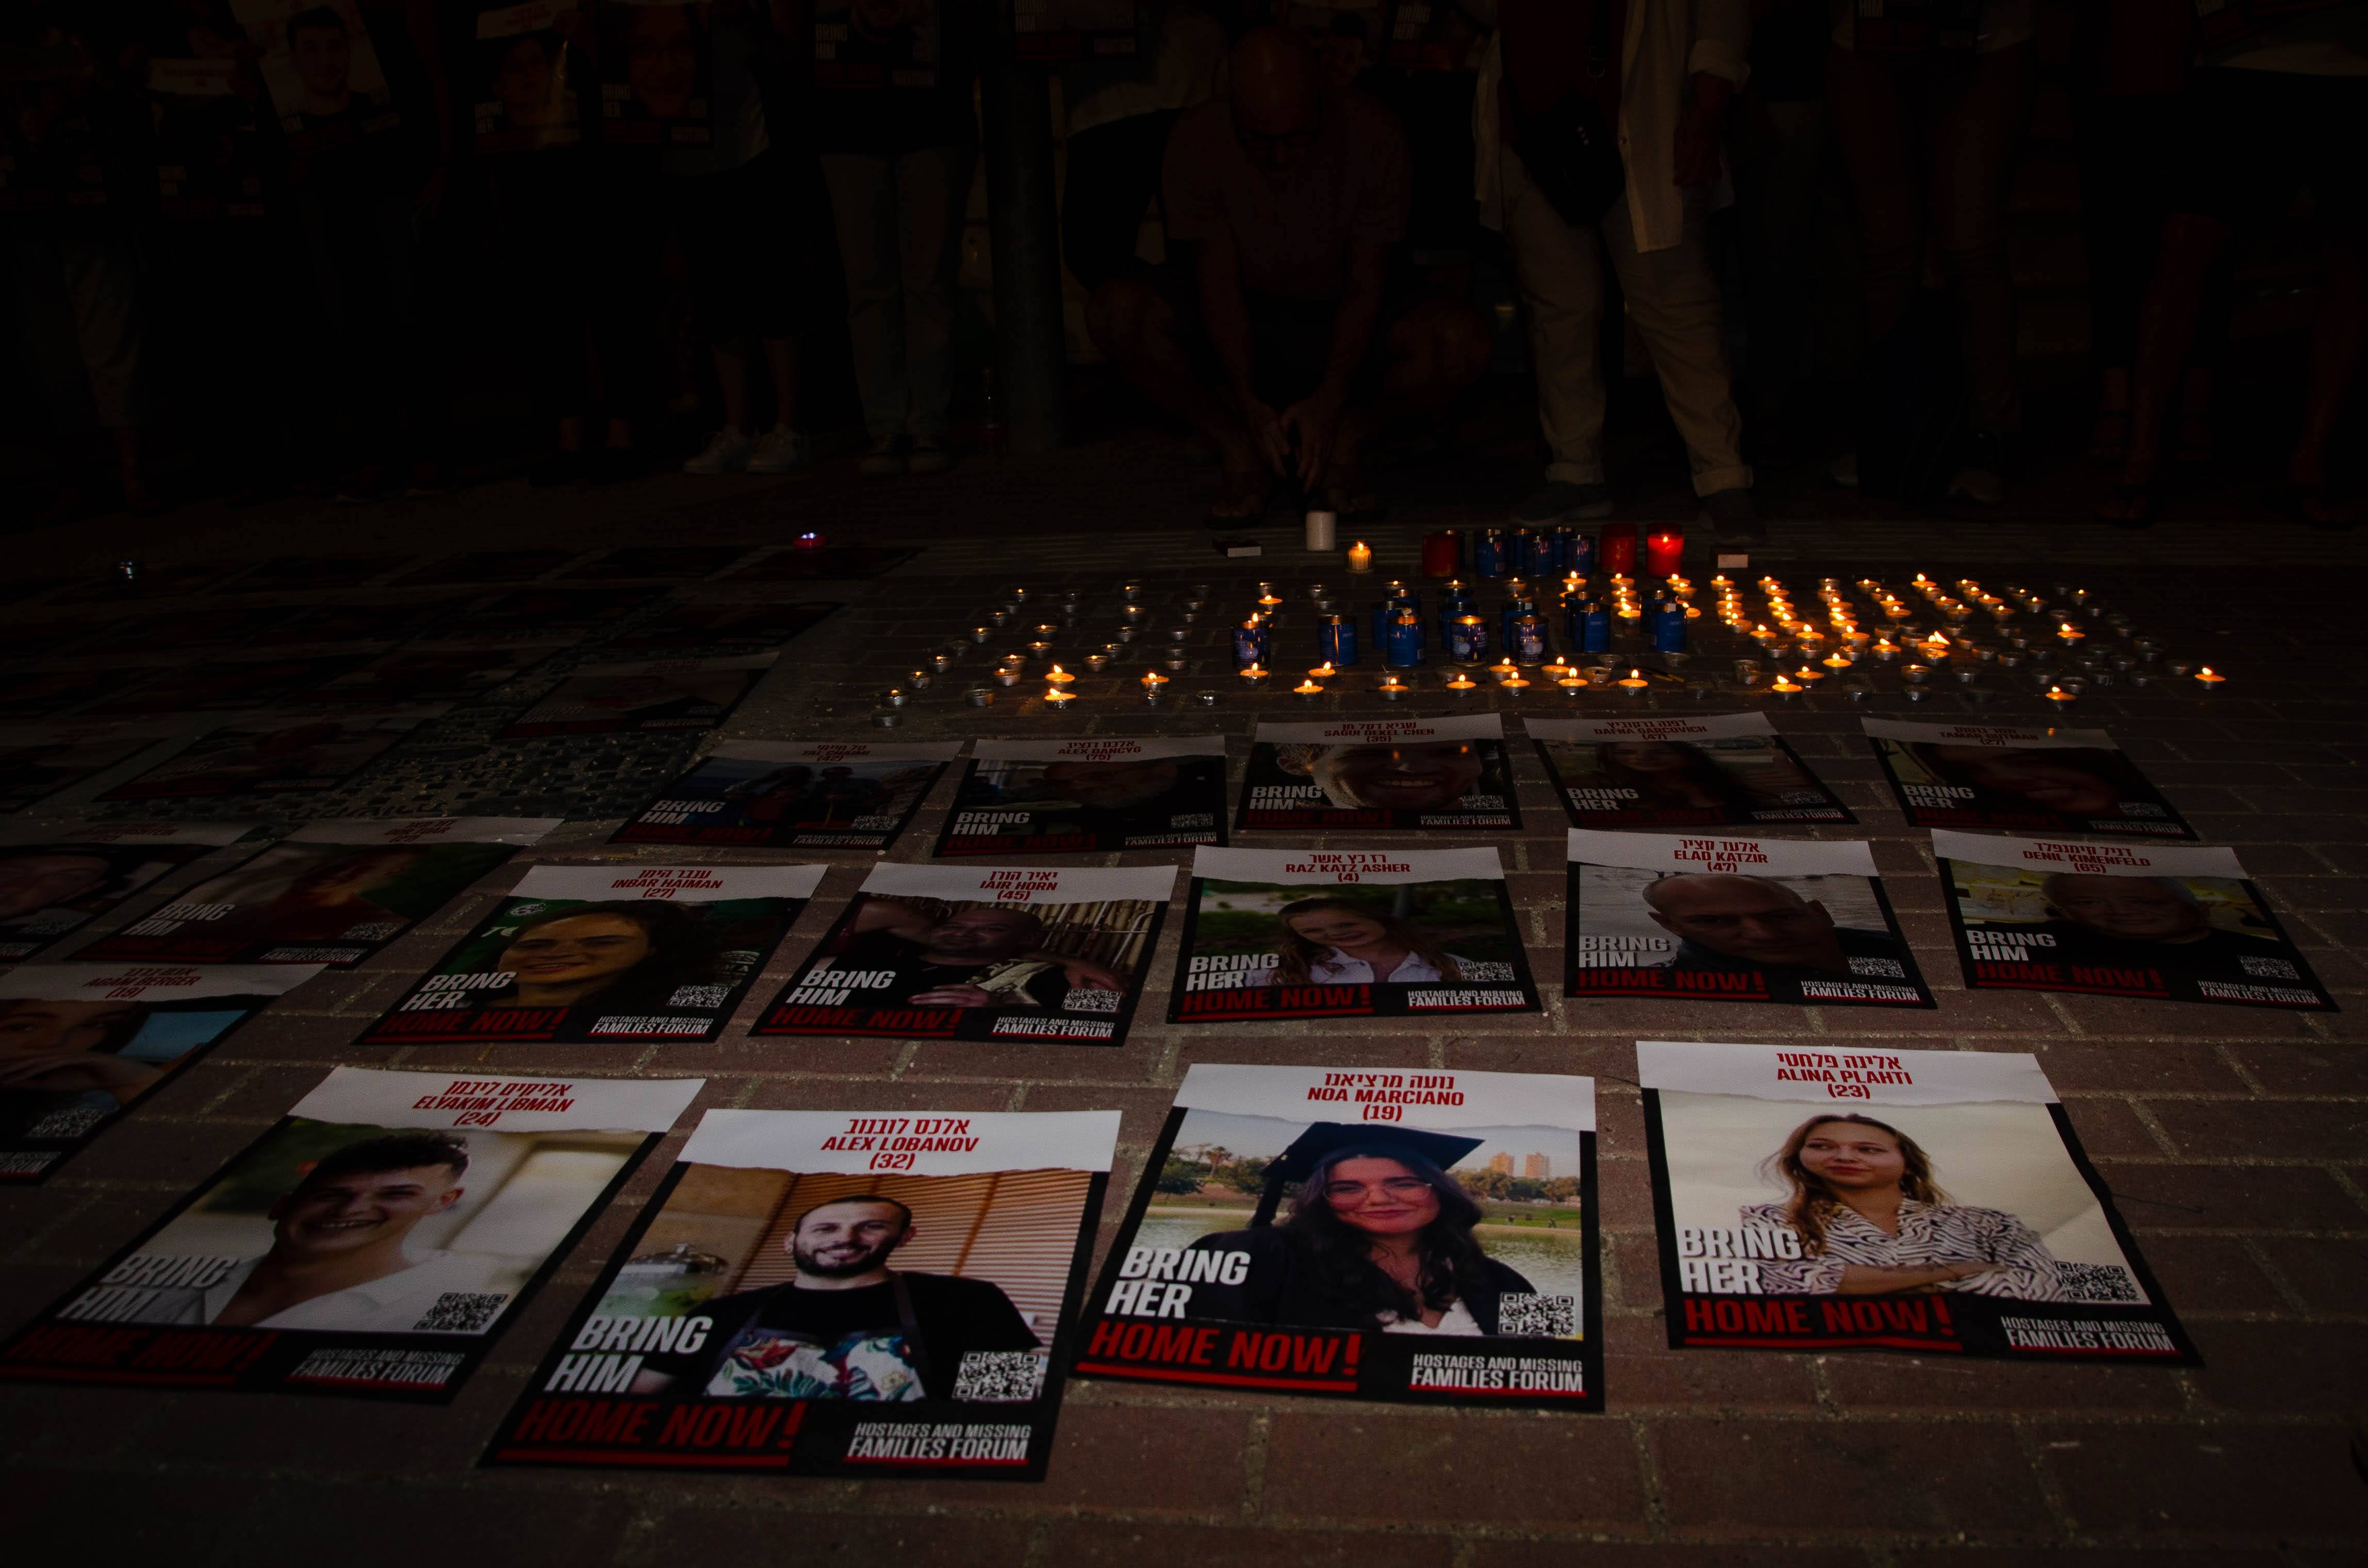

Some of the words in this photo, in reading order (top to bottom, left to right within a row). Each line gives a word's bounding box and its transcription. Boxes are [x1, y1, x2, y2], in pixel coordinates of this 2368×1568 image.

[816, 24, 847, 41] BRING
[816, 42, 835, 60] HIM
[602, 83, 631, 100] BRING
[1251, 785, 1322, 798] BRING
[1566, 788, 1639, 800] BRING
[1902, 784, 1976, 799] BRING
[650, 800, 726, 813] BRING
[1249, 798, 1294, 810] HIM
[1571, 799, 1620, 811] HER
[1908, 796, 1956, 808] HER
[637, 812, 689, 825] HIM
[957, 812, 1030, 823] BRING
[951, 823, 1000, 835] HIM
[1679, 839, 1714, 851] קציר
[1719, 841, 1759, 852] אלעד
[2100, 847, 2132, 856] דניל
[1309, 854, 1342, 863] אשר
[1347, 854, 1366, 864] כץ
[1370, 854, 1386, 863] רז
[1674, 850, 1712, 861] ELAD
[1716, 852, 1768, 863] KATZIR
[2022, 851, 2065, 861] DENIL
[2068, 854, 2151, 866] KIMENFELD
[637, 870, 673, 879] הימן
[677, 870, 712, 878] ענבר
[1362, 864, 1410, 872] ASHER
[1707, 862, 1737, 873] (47)
[2074, 863, 2107, 873] (65)
[611, 879, 660, 888] INBAR
[660, 880, 724, 888] HAIMAN
[990, 871, 1022, 881] הורן
[1027, 872, 1059, 881] יאיר
[1338, 872, 1359, 882] (4)
[643, 888, 676, 898] (27)
[980, 881, 1012, 889] IAIR
[1014, 882, 1058, 890] HORN
[997, 890, 1030, 901] (45)
[148, 903, 236, 921] BRING
[120, 920, 185, 936] HIM
[1579, 936, 1670, 952] BRING
[1965, 930, 2058, 947] BRING
[1578, 951, 1635, 968] HIM
[1970, 945, 2029, 961] HIM
[1189, 953, 1279, 973] BRING
[420, 971, 517, 992] BRING
[800, 969, 896, 988] BRING
[1186, 970, 1246, 992] HER
[105, 986, 146, 998] (19)
[785, 987, 851, 1006] HIM
[1182, 989, 1271, 1012] HOME
[1280, 984, 1370, 1008] NOW!
[1803, 987, 1867, 998] FAMILIES
[1868, 989, 1920, 1001] FORUM
[2201, 986, 2265, 1000] FAMILIES
[2267, 991, 2321, 1004] FORUM
[399, 991, 466, 1011] HER
[1408, 997, 1472, 1006] FAMILIES
[1474, 996, 1526, 1005] FORUM
[591, 1022, 656, 1033] FAMILIES
[656, 1023, 710, 1034] FORUM
[992, 1022, 1058, 1035] FAMILIES
[1060, 1026, 1113, 1037] FORUM
[1777, 1053, 1839, 1068] פלחטי
[1843, 1055, 1903, 1069] אלינה
[1325, 1073, 1403, 1087] מרציאנו
[1410, 1075, 1454, 1089] נועה
[1778, 1068, 1836, 1082] ALINA
[1839, 1070, 1913, 1084] PLAHTI
[443, 1081, 503, 1095] ליבמן
[499, 1083, 573, 1097] אליקים
[1828, 1083, 1870, 1099] (23)
[1307, 1087, 1349, 1101] NOA
[1355, 1089, 1464, 1105] MARCIANO
[412, 1096, 498, 1110] ELYAKIM
[495, 1097, 575, 1112] LIBMAN
[453, 1111, 502, 1126] (24)
[1363, 1104, 1402, 1121] (19)
[844, 1118, 910, 1134] לובנוב
[914, 1118, 970, 1134] אלכס
[820, 1136, 877, 1150] ALEX
[879, 1137, 979, 1151] LOBANOV
[869, 1152, 916, 1170] (32)
[1679, 1227, 1802, 1261] BRING
[97, 1255, 239, 1289] BRING
[1119, 1247, 1252, 1285] BRING
[1681, 1261, 1764, 1294] HER
[55, 1286, 162, 1322] HIM
[1104, 1280, 1192, 1319] HER
[1684, 1298, 1812, 1333] HOME
[1820, 1295, 1955, 1336] NOW!
[2000, 1316, 2071, 1330] HOSTAGES
[2073, 1319, 2102, 1331] AND
[2102, 1320, 2165, 1334] MISSING
[569, 1315, 714, 1355] BRING
[2005, 1329, 2099, 1348] FAMILIES
[2099, 1332, 2176, 1351] FORUM
[1087, 1320, 1221, 1365] HOME
[1227, 1331, 1362, 1376] NOW!
[1413, 1354, 1485, 1369] HOSTAGES
[1487, 1357, 1517, 1370] AND
[1519, 1358, 1583, 1373] MISSING
[290, 1361, 384, 1379] FAMILIES
[379, 1362, 457, 1384] FORUM
[544, 1354, 645, 1393] HIM
[1411, 1367, 1504, 1389] FAMILIES
[1509, 1371, 1583, 1393] FORUM
[512, 1398, 660, 1444] HOME
[657, 1401, 809, 1449] NOW!
[854, 1422, 931, 1438] HOSTAGES
[931, 1424, 963, 1438] AND
[964, 1424, 1031, 1439] MISSING
[847, 1436, 947, 1459] FAMILIES
[948, 1438, 1029, 1460] FORUM
